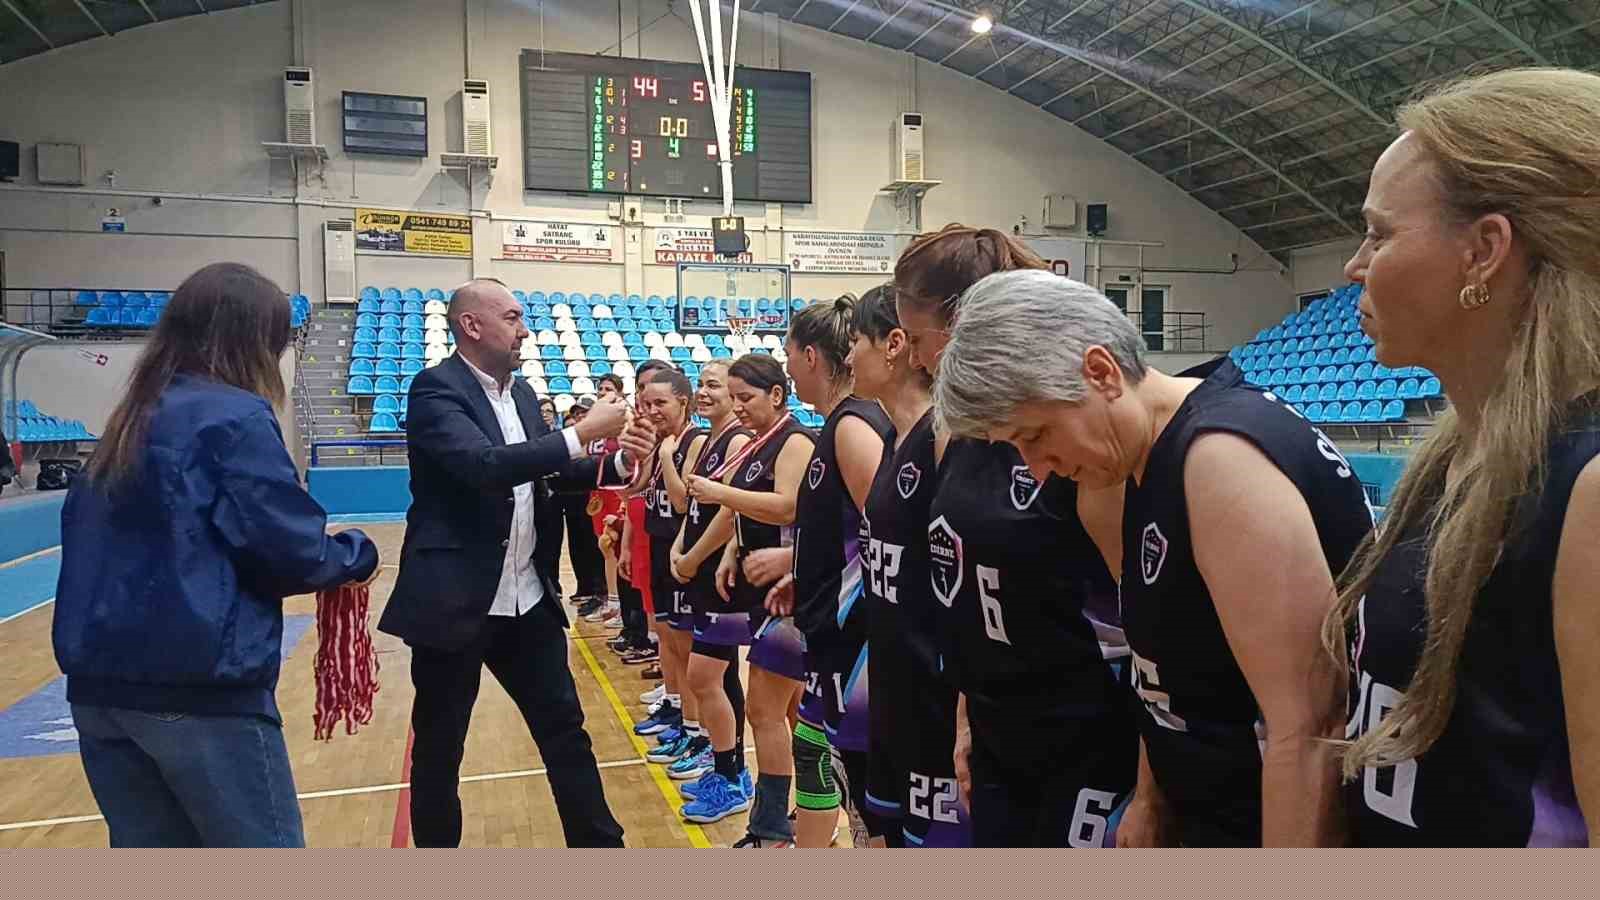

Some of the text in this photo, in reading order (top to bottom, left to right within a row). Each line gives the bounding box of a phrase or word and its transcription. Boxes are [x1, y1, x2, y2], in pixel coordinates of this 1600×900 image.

[633, 77, 658, 97] 44
[693, 81, 704, 101] 5
[631, 139, 642, 158] 3
[669, 138, 679, 153] 4
[109, 208, 118, 217] 2
[656, 251, 752, 264] KARATE KUSU
[869, 537, 905, 604] 22
[976, 563, 1013, 647] 6
[909, 771, 961, 824] 22
[1067, 787, 1119, 848] 6
